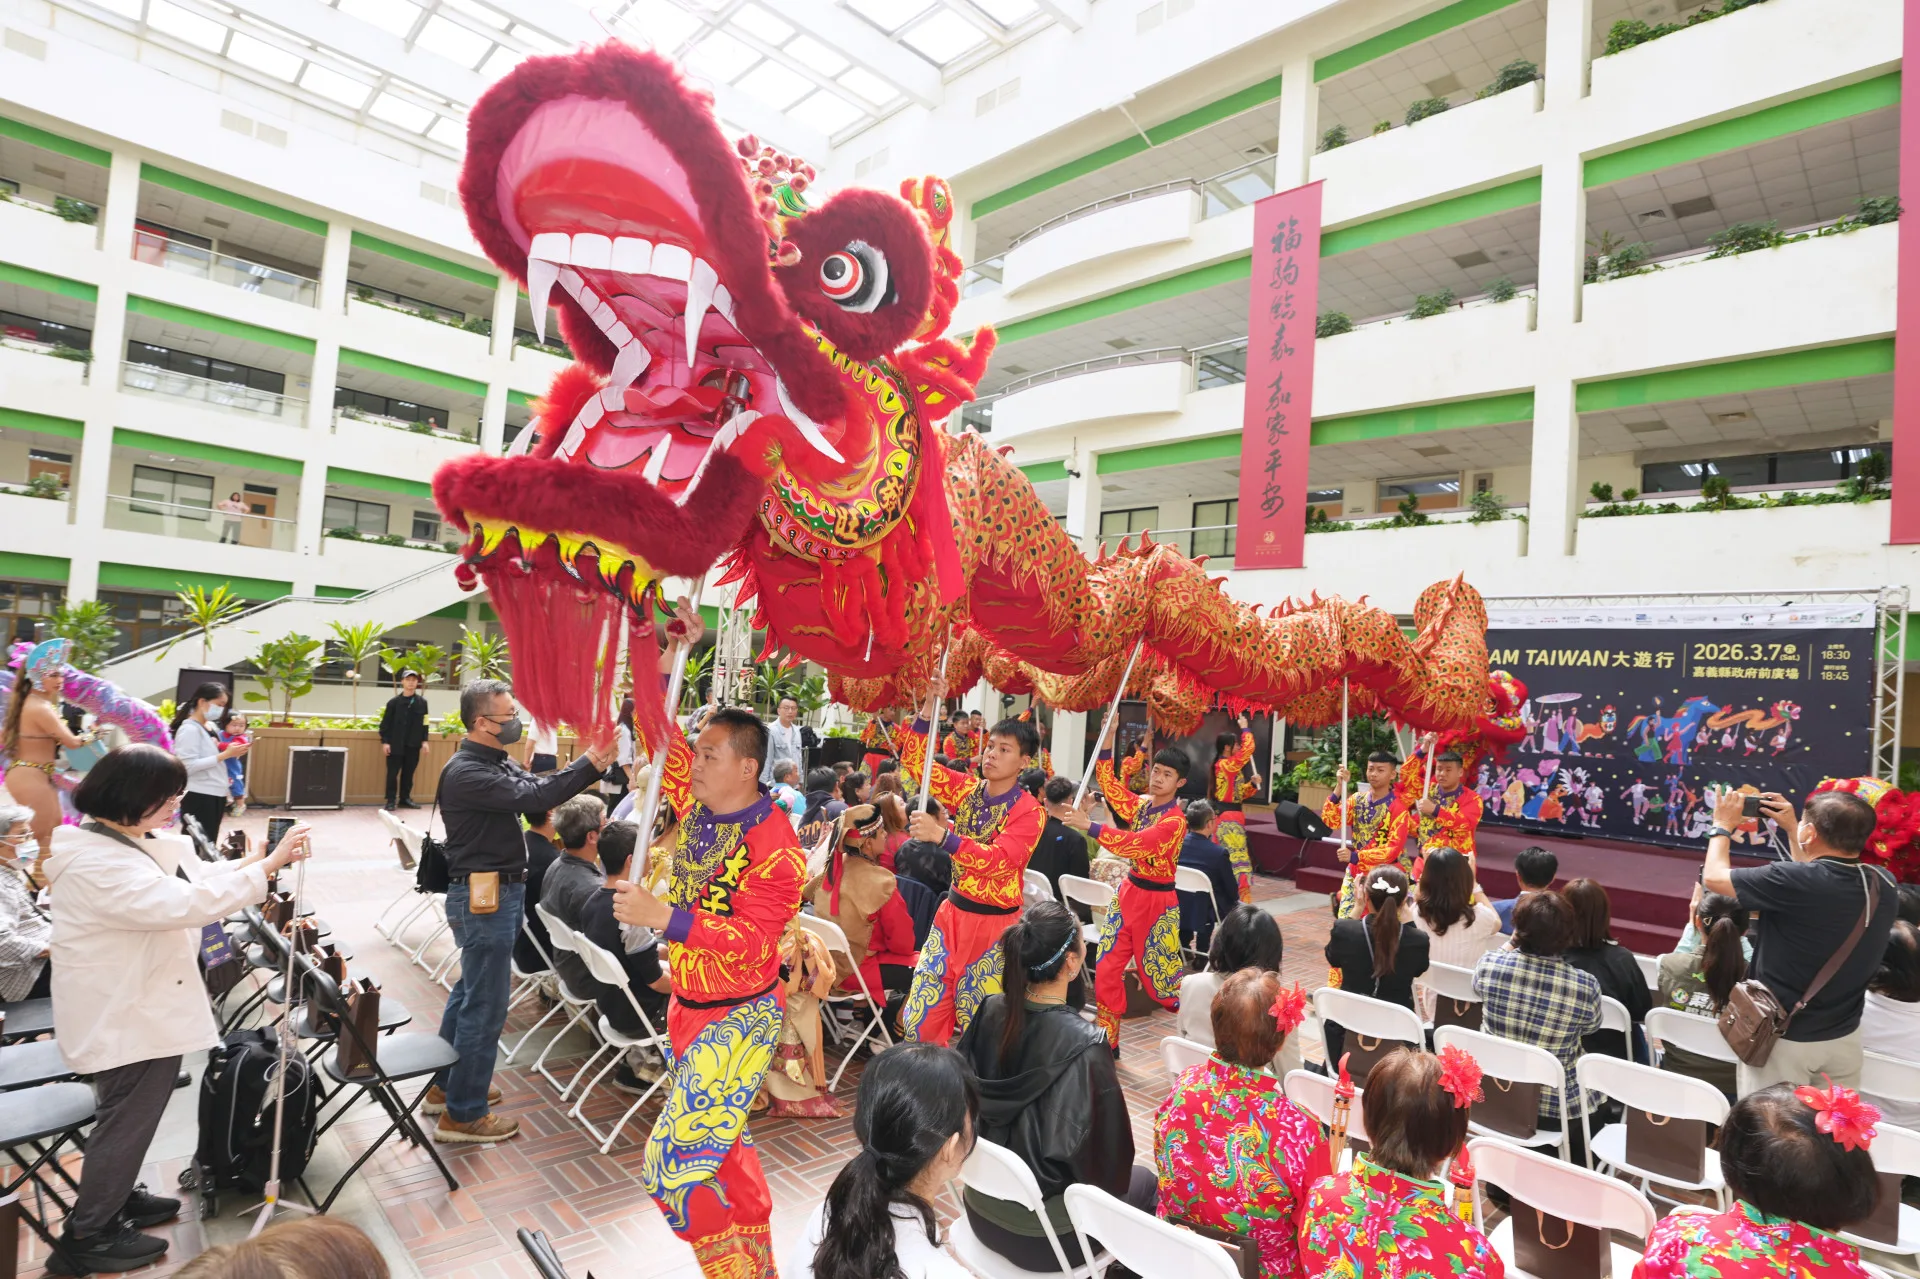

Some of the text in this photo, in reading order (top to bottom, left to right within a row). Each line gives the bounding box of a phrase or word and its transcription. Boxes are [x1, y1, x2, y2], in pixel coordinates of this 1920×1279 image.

[1488, 649, 1675, 669] AM TAIWAN 大遊行
[1693, 643, 1782, 661] 2026.3.7
[1821, 650, 1851, 660] 18:30
[1693, 666, 1800, 680] 嘉義縣政府前廣場
[1821, 671, 1850, 681] 18:45
